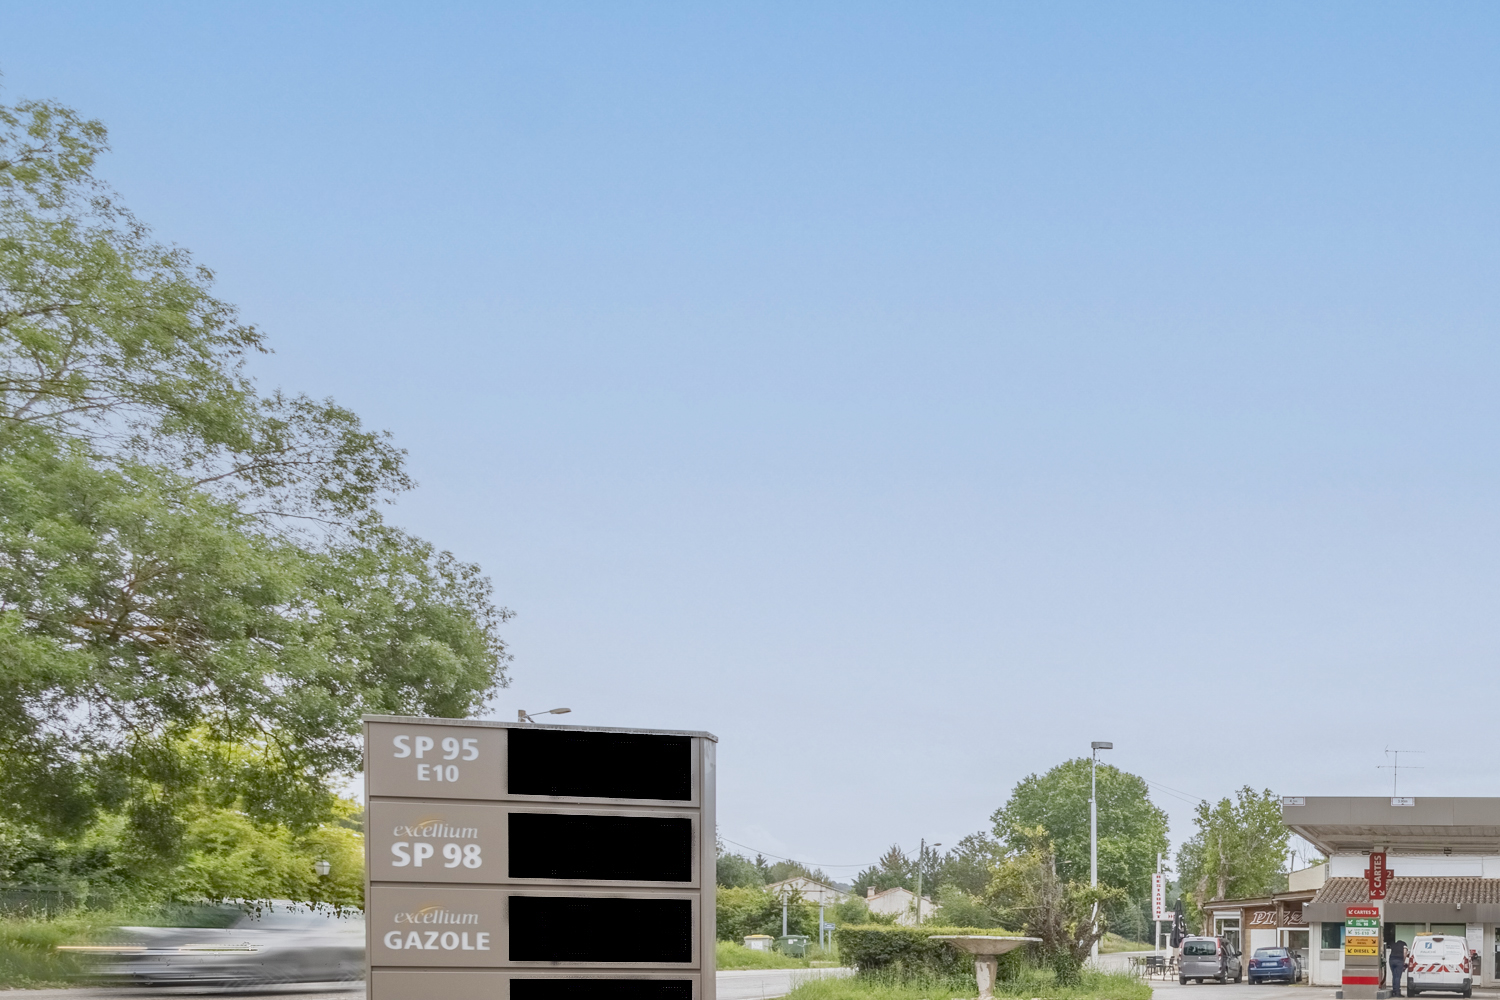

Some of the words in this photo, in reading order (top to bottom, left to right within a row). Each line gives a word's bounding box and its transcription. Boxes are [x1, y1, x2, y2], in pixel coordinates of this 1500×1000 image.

[392, 734, 434, 759] SP
[441, 736, 479, 761] 95
[417, 763, 459, 782] E10
[393, 823, 478, 839] excellium
[391, 841, 434, 867] SP
[442, 843, 482, 869] 98
[1374, 855, 1382, 888] CARTES
[1386, 870, 1392, 878] 2
[394, 909, 479, 925] excellium
[384, 930, 490, 950] GAZOLE
